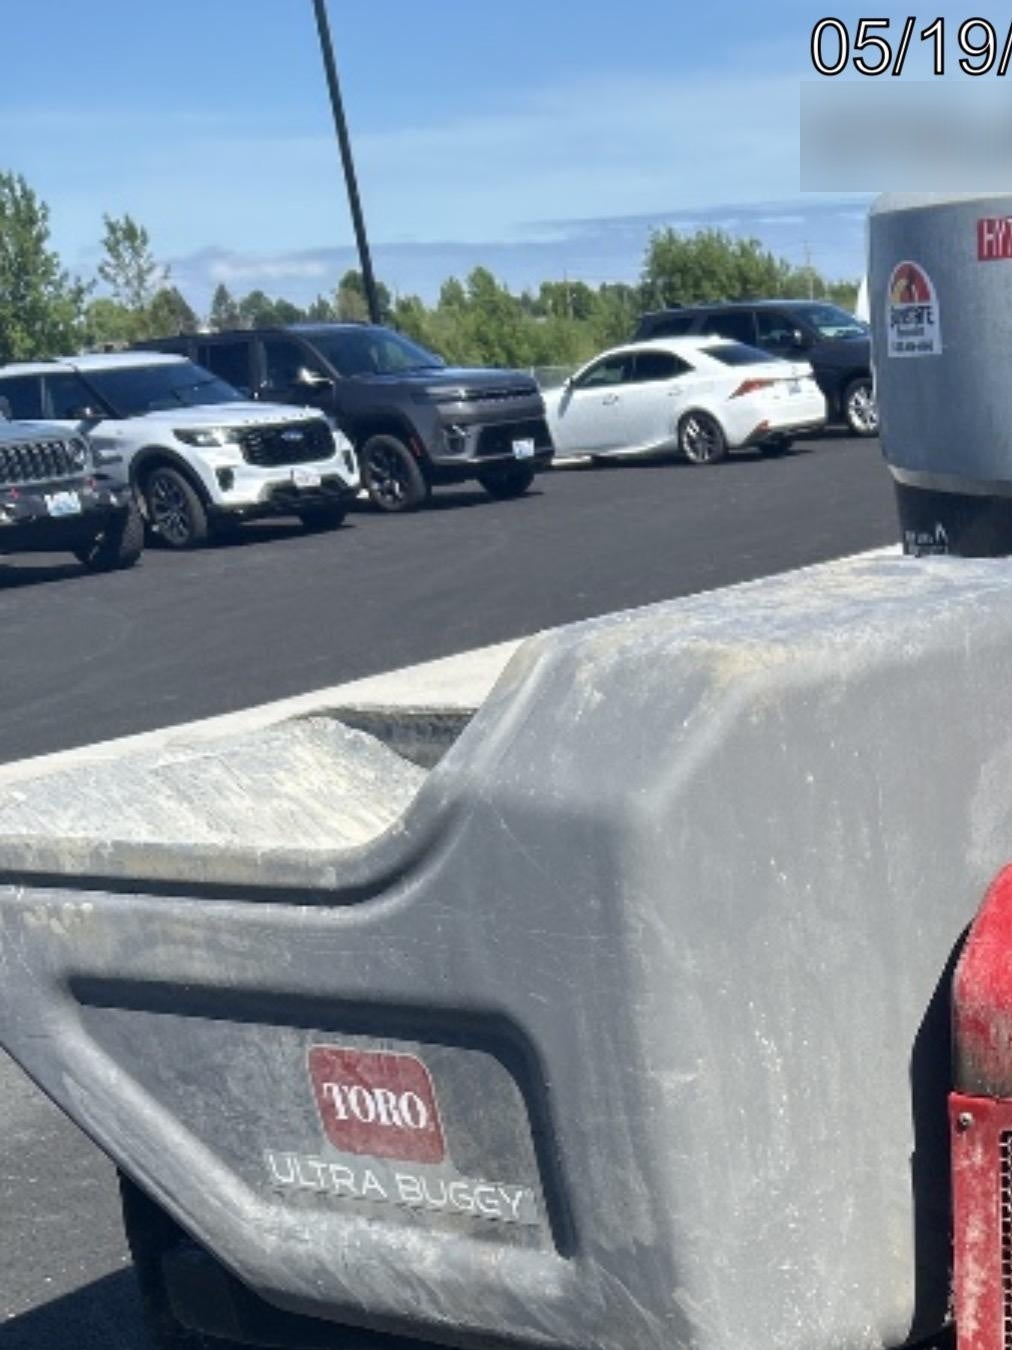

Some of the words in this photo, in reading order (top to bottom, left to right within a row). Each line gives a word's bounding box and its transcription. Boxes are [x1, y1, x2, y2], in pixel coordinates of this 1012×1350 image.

[323, 1082, 428, 1129] TORO
[268, 1154, 387, 1198] ULTRA
[396, 1172, 524, 1218] BUGGY
